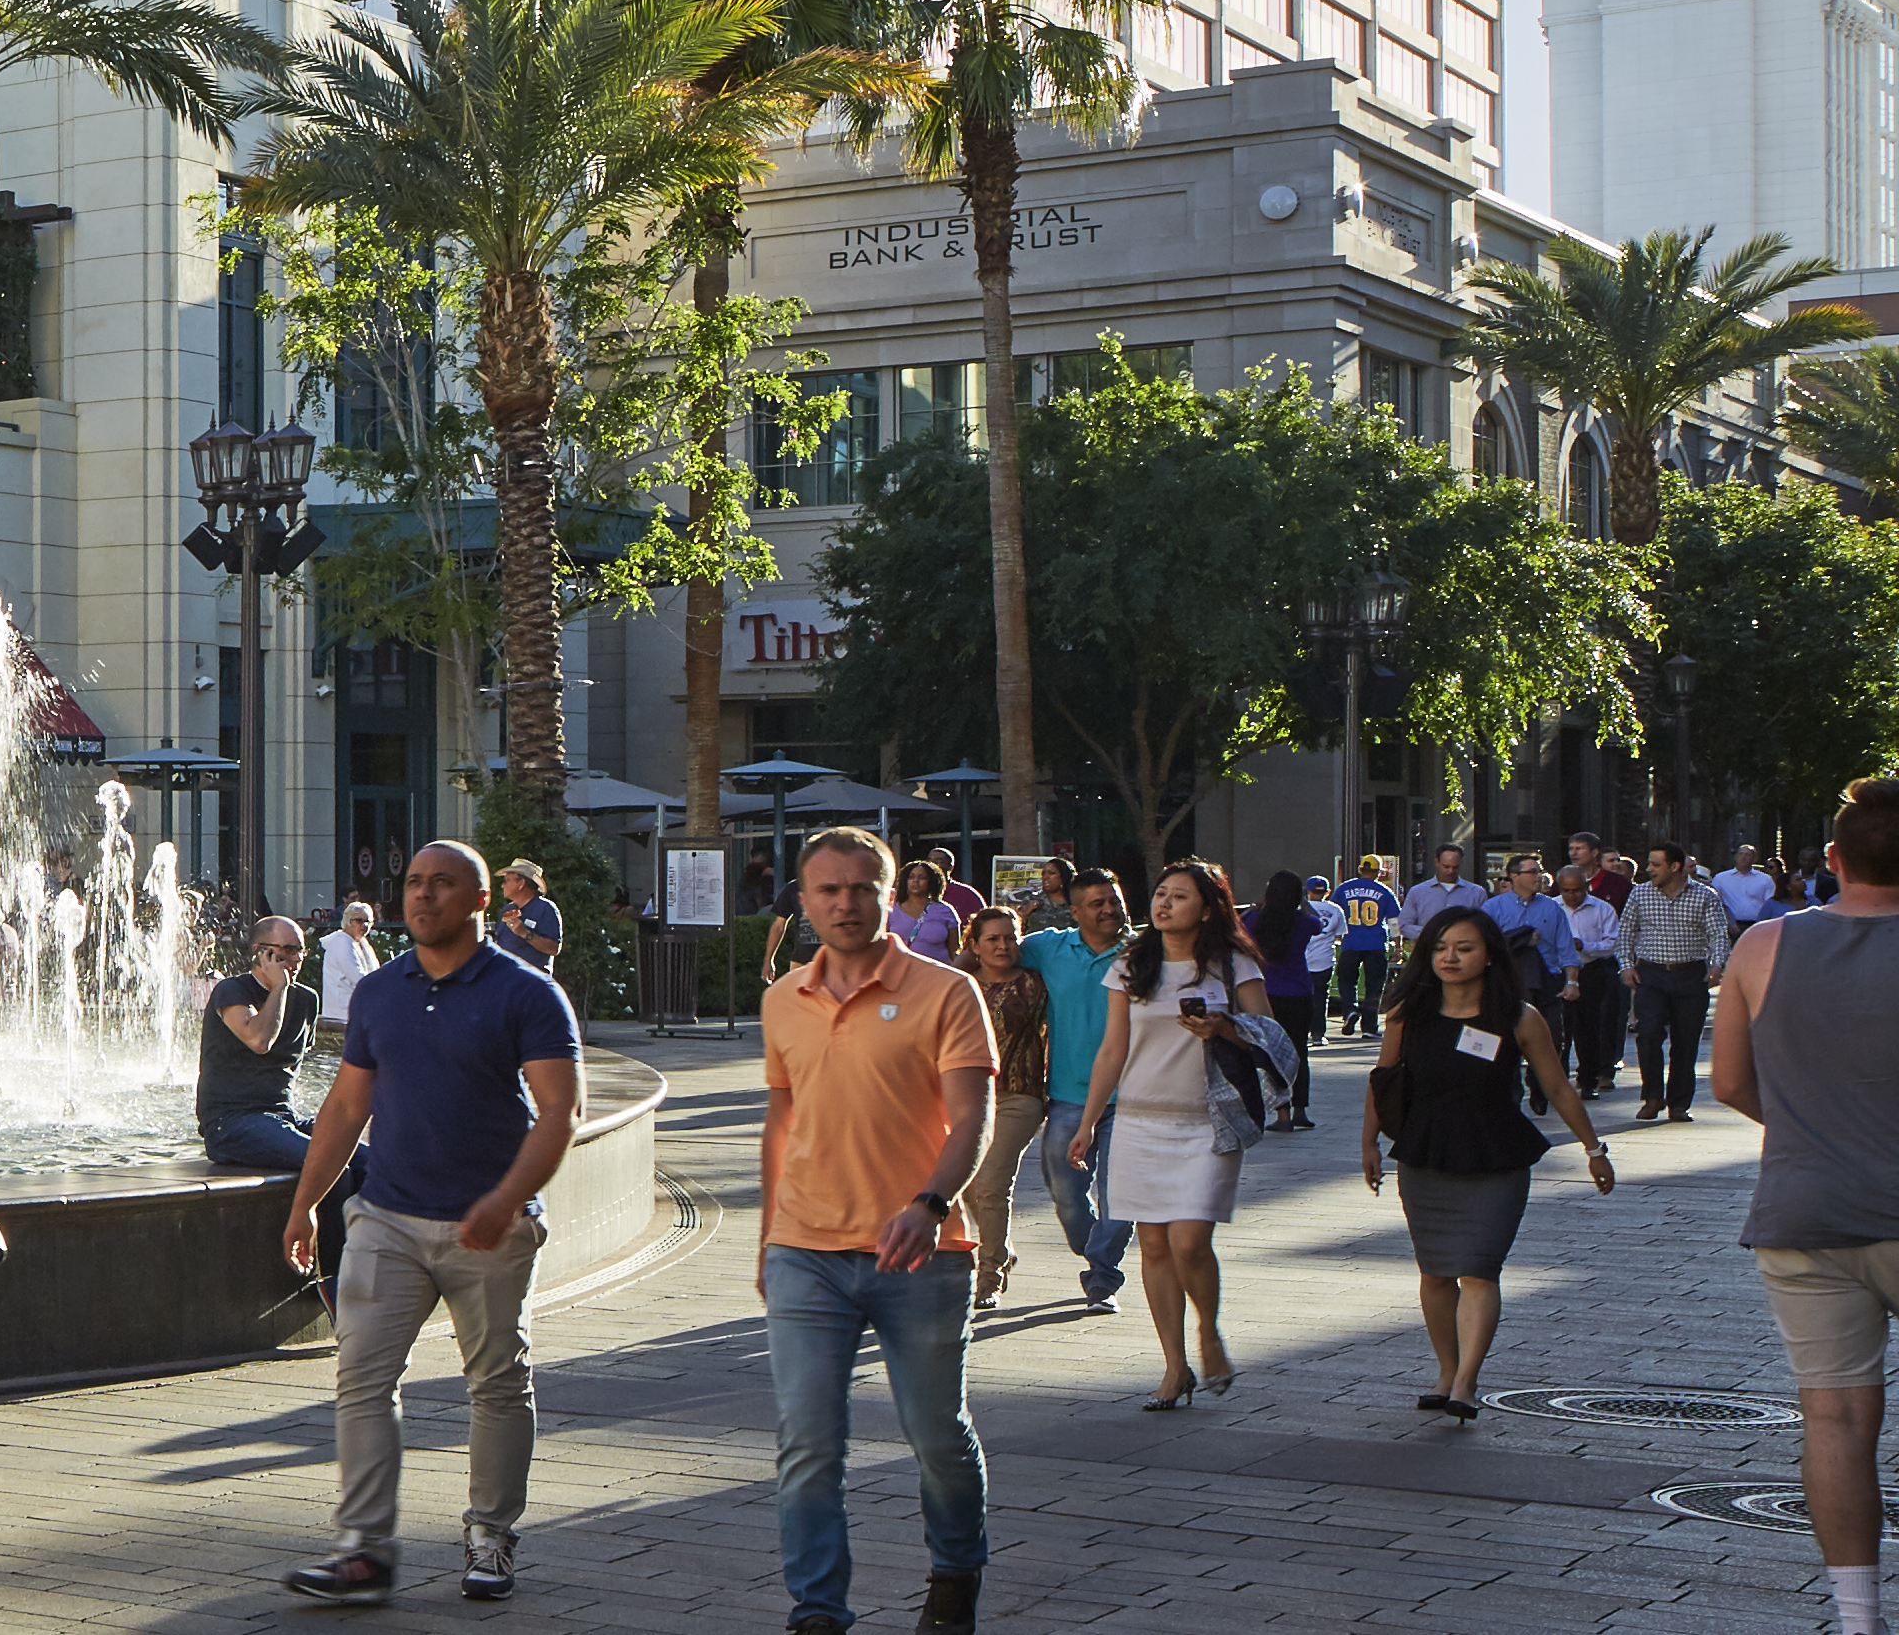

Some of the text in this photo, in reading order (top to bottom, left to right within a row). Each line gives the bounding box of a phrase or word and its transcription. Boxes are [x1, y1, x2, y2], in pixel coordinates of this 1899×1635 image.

[829, 224, 1103, 270] BANK & RUST
[844, 205, 1091, 247] INDUSRIAL
[739, 612, 850, 663] Tilt
[1348, 899, 1379, 927] 10
